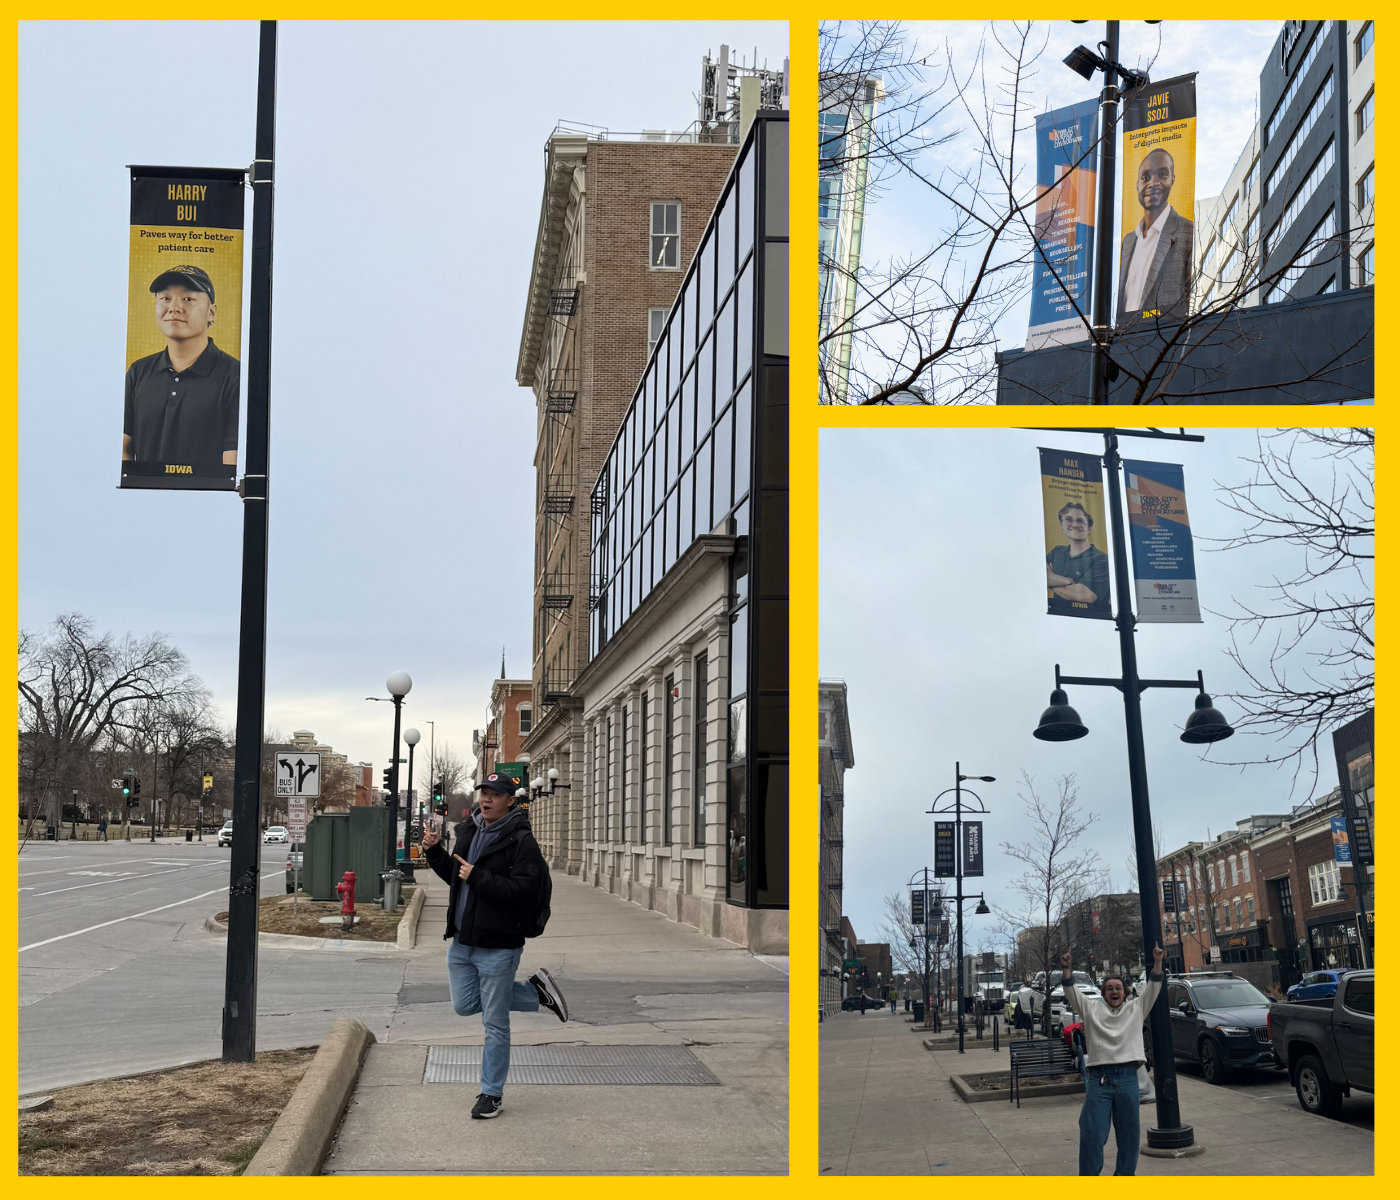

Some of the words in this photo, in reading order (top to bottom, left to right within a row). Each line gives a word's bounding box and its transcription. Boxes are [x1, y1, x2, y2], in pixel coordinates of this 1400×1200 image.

[1147, 91, 1170, 108] JAVIE
[1147, 106, 1169, 123] SSOZI
[1129, 128, 1161, 141] Interprets
[1161, 122, 1188, 133] impacts
[1134, 140, 1140, 149] of
[1140, 136, 1161, 147] digital
[1161, 132, 1182, 142] media
[167, 184, 208, 202] HARRY
[176, 204, 197, 222] BUI
[1057, 216, 1081, 227] READERS
[139, 229, 167, 239] Paves
[168, 231, 188, 241] way
[188, 231, 203, 240] for
[204, 231, 234, 242] better
[1051, 227, 1076, 238] TEACHERS
[157, 243, 193, 253] patient
[194, 245, 215, 254] care
[1055, 303, 1072, 313] POETS
[1063, 458, 1079, 468] MAX
[164, 464, 194, 475] IOWA
[1058, 467, 1085, 479] HANSEN
[1048, 484, 1077, 493] prevention
[1051, 478, 1069, 486] Brings
[1069, 480, 1094, 488] dementia
[1071, 601, 1089, 609] IOWA
[279, 778, 292, 786] BUS
[277, 786, 294, 794] ONLY
[1346, 927, 1357, 937] RE
